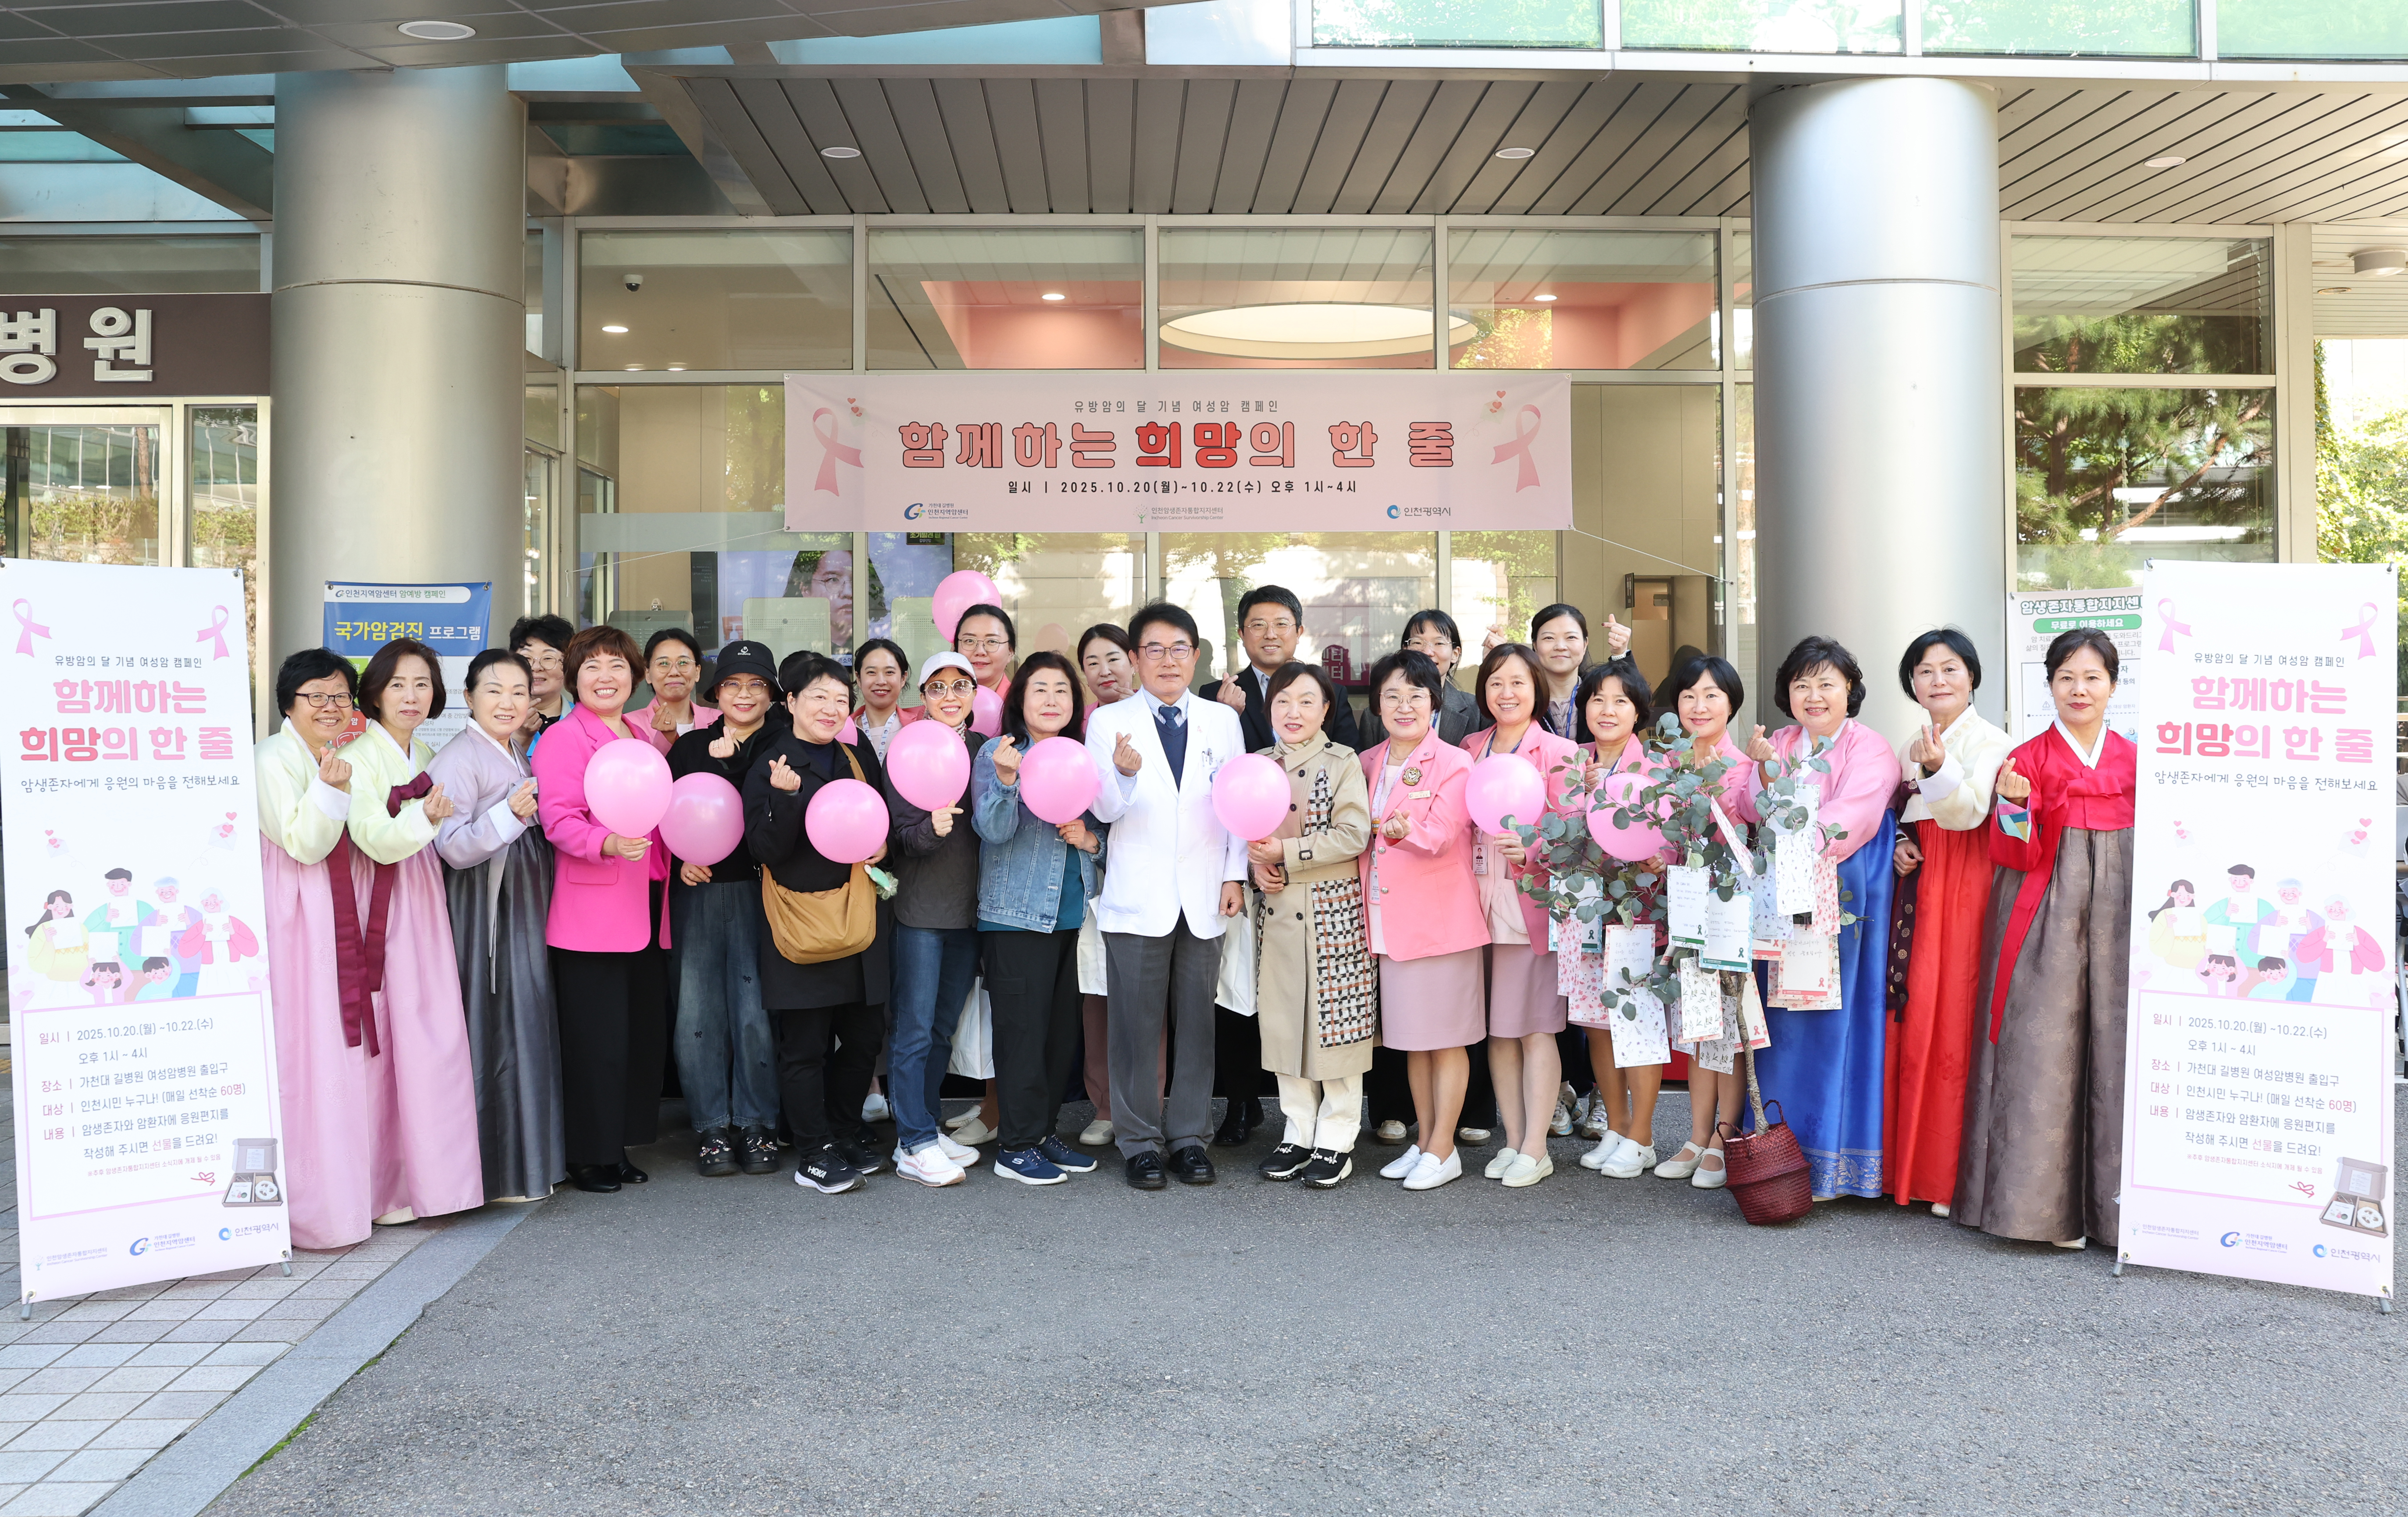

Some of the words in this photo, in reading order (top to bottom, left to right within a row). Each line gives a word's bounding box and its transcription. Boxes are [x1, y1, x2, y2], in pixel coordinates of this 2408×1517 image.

[0, 307, 153, 384] 병원
[1075, 401, 1124, 412] 유방암의
[1137, 401, 1146, 412] 달
[1158, 401, 1180, 412] 기념
[1193, 401, 1229, 412] 여성암
[1241, 401, 1277, 412] 캠페인
[898, 421, 1116, 468] 함께하는
[1135, 421, 1294, 468] 희망의
[1329, 421, 1378, 468] 한
[1408, 422, 1454, 467] 줄
[1009, 481, 1030, 493] 일시
[1062, 481, 1261, 494] 2025.10.20(월)~10.22(수)
[1272, 480, 1293, 493] 오후
[1305, 481, 1355, 492] 1시~4시
[1404, 508, 1450, 516] 인천광역시
[335, 622, 423, 641] 국가암검진
[429, 626, 480, 640] 프로그램
[2050, 619, 2077, 630] 무료로
[2079, 618, 2124, 629] 이용하세요
[56, 656, 95, 666] 유방암의
[102, 657, 110, 666] 달
[116, 657, 134, 667] 기념
[140, 657, 168, 667] 여성암
[174, 658, 201, 668] 캠페인
[2194, 653, 2233, 663] 유방암의
[2240, 654, 2248, 664] 달
[2254, 655, 2272, 665] 기념
[2279, 655, 2308, 666] 여성암
[2315, 657, 2344, 667] 캠페인
[53, 679, 207, 713] 함께하는
[2191, 676, 2347, 714] 함께하는
[20, 727, 138, 761] 희망의
[149, 727, 187, 760] 한
[198, 727, 233, 760] 줄
[2156, 721, 2270, 758] 희망의
[2283, 726, 2323, 761] 한
[2335, 728, 2373, 763] 줄
[21, 778, 98, 792] 암생존자에게
[105, 777, 138, 790] 응원의
[143, 776, 177, 789] 마음을
[182, 775, 239, 789] 전해보세요
[2155, 771, 2228, 784] 암생존자에게
[2234, 774, 2268, 787] 응원의
[2274, 776, 2309, 790] 마음을
[2315, 778, 2377, 790] 전해보세요
[39, 1032, 59, 1044] 일시
[77, 1023, 156, 1040] 2025.10.20.(월)
[160, 1018, 213, 1032] ~10.22.(수)
[2154, 1014, 2171, 1025] 일시
[2189, 1017, 2266, 1034] 2025.10.20.(월)
[2271, 1025, 2326, 1039] ~10.22.(수)
[79, 1052, 98, 1064] 오후
[103, 1050, 118, 1061] 1시
[132, 1048, 147, 1058] 4시
[2188, 1040, 2207, 1051] 오후
[2212, 1042, 2226, 1053] 1시
[2240, 1045, 2255, 1055] 4시
[42, 1080, 61, 1092] 장소
[80, 1075, 109, 1087] 가천대
[114, 1071, 143, 1084] 길병원
[148, 1066, 196, 1080] 여성암병원
[200, 1062, 228, 1076] 출입구
[2152, 1059, 2170, 1070] 장소
[2187, 1062, 2216, 1075] 가천대
[2221, 1066, 2249, 1078] 길병원
[2254, 1069, 2304, 1084] 여성암병원
[2309, 1073, 2339, 1087] 출입구
[43, 1104, 63, 1116] 대상
[81, 1097, 121, 1112] 인천시민
[126, 1094, 158, 1107] 누구나!
[163, 1090, 184, 1103] (매일
[189, 1087, 217, 1100] 선착순
[221, 1083, 245, 1095] 60명)
[2151, 1082, 2170, 1094] 대상
[2187, 1086, 2225, 1099] 인천시민
[2230, 1090, 2262, 1102] 누구나!
[2267, 1093, 2290, 1106] (매일
[2295, 1096, 2325, 1109] 선착순
[2329, 1100, 2356, 1113] 60명)
[44, 1128, 64, 1140] 내용
[82, 1119, 133, 1136] 암생존자와
[137, 1115, 176, 1130] 암환자에
[181, 1108, 228, 1124] 응원편지를
[2150, 1105, 2168, 1117] 내용
[2186, 1108, 2236, 1123] 암생존자와
[2240, 1114, 2279, 1128] 암환자에
[2284, 1119, 2335, 1134] 응원편지를
[84, 1146, 114, 1159] 작성해
[119, 1141, 148, 1155] 주시면
[153, 1137, 181, 1151] 선물을
[186, 1133, 217, 1147] 드려요!
[2186, 1132, 2214, 1145] 작성해
[2219, 1135, 2248, 1149] 주시면
[2253, 1139, 2282, 1152] 선물을
[2287, 1143, 2320, 1156] 드려요!
[106, 1162, 160, 1175] 암생존자통합지지센터
[2205, 1155, 2258, 1167] 암생존자통합지지센터
[807, 1165, 827, 1179] HOKA
[235, 1223, 278, 1236] 인천광역시
[2142, 1224, 2200, 1235] 인천암생존자통합지지센터
[153, 1236, 196, 1248] 인천지역암센터
[2244, 1238, 2288, 1251] 인천지역암센터
[46, 1247, 108, 1261] 인천암생존자통합지지센터
[2331, 1249, 2380, 1262] 인천광역시
